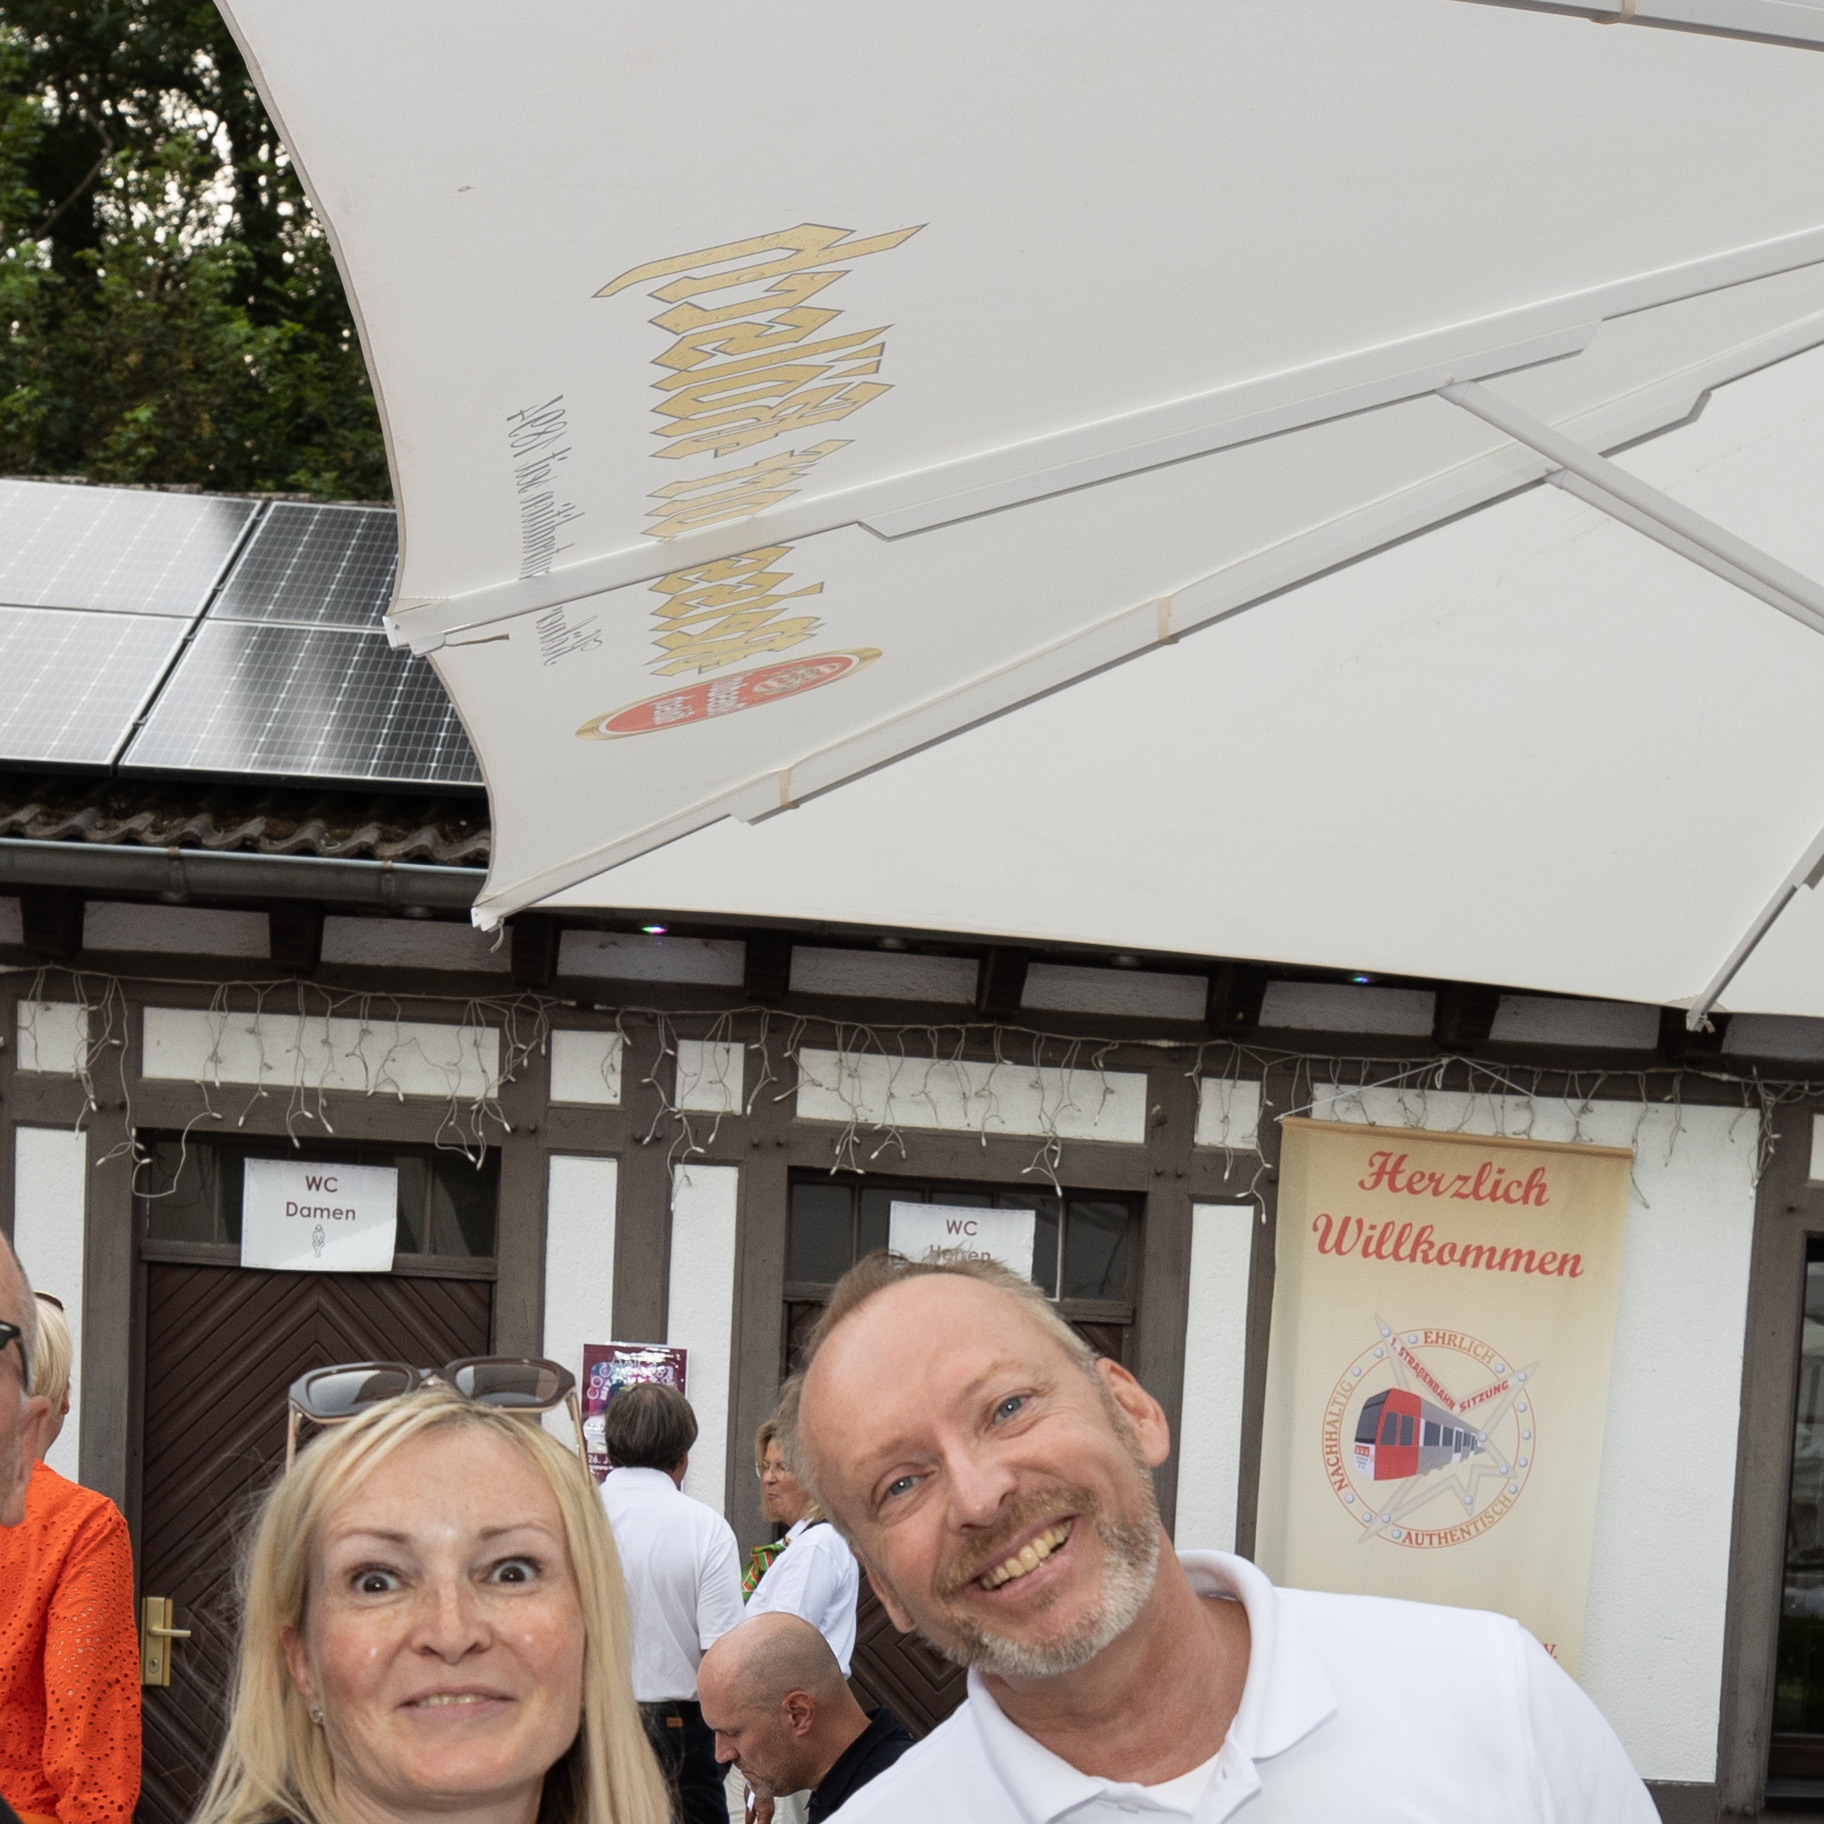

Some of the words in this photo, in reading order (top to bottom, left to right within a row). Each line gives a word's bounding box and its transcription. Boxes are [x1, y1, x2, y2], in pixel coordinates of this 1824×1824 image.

[305, 1174, 339, 1193] WC
[1359, 1151, 1550, 1206] Herzlich
[285, 1201, 356, 1221] Damen
[946, 1219, 978, 1236] WC
[1312, 1215, 1584, 1278] Willkommen
[1422, 1330, 1496, 1365] EHRLICH
[1459, 1380, 1510, 1413] SITZUNG
[1325, 1380, 1354, 1492] NACHHALTIG
[1401, 1493, 1513, 1546] AUTHENTISCH
